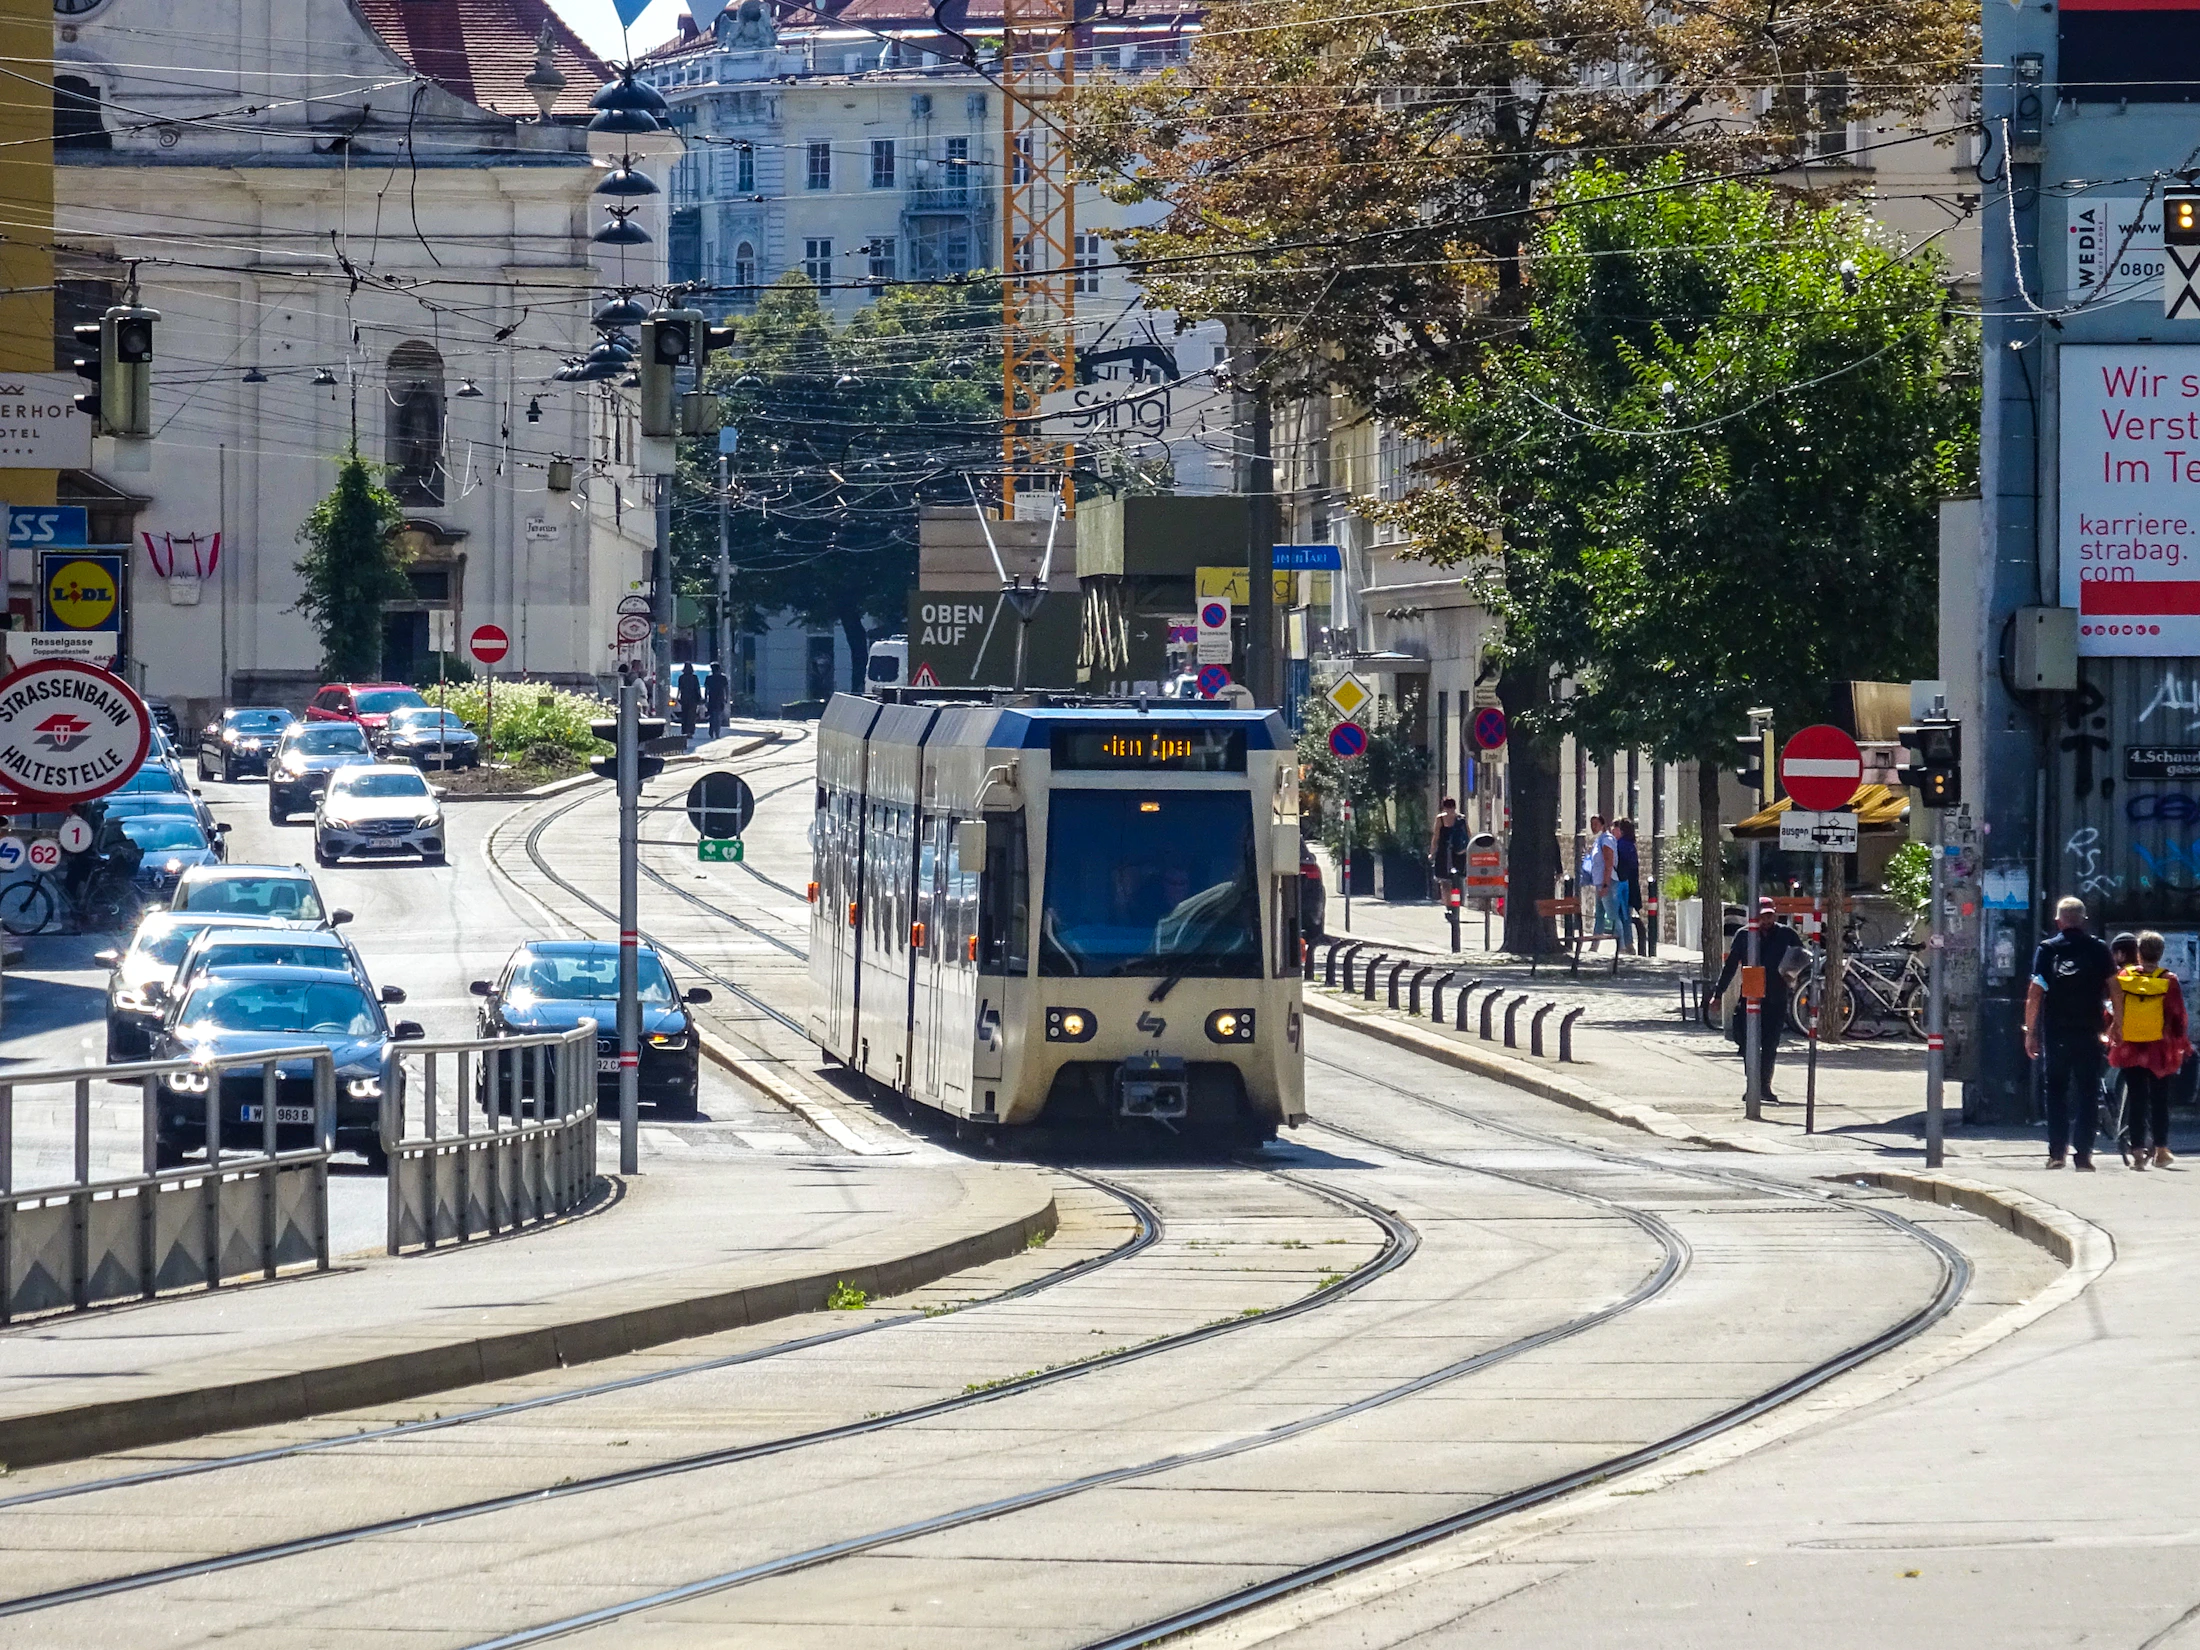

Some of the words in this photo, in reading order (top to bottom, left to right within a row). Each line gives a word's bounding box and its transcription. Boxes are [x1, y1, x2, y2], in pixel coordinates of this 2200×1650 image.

[2071, 208, 2095, 288] WEDIA
[2120, 263, 2165, 276] 0800
[2101, 365, 2168, 398] Wir
[2181, 375, 2200, 398] s
[1, 404, 75, 418] ERHOF
[1073, 390, 1171, 437] Stingl
[2101, 408, 2200, 440] Verst
[2105, 451, 2149, 483] Im
[2164, 451, 2200, 483] Te
[2080, 513, 2196, 536] karriere.
[2080, 538, 2188, 566] strabag.
[2079, 565, 2134, 582] com
[921, 604, 984, 625] OBEN
[31, 638, 93, 647] Resselgasse
[921, 627, 967, 646] AUF
[0, 678, 131, 727] STRASSENBAHN
[0, 745, 123, 786] HALTESTELLE
[71, 827, 81, 844] 1
[30, 845, 57, 864] 62
